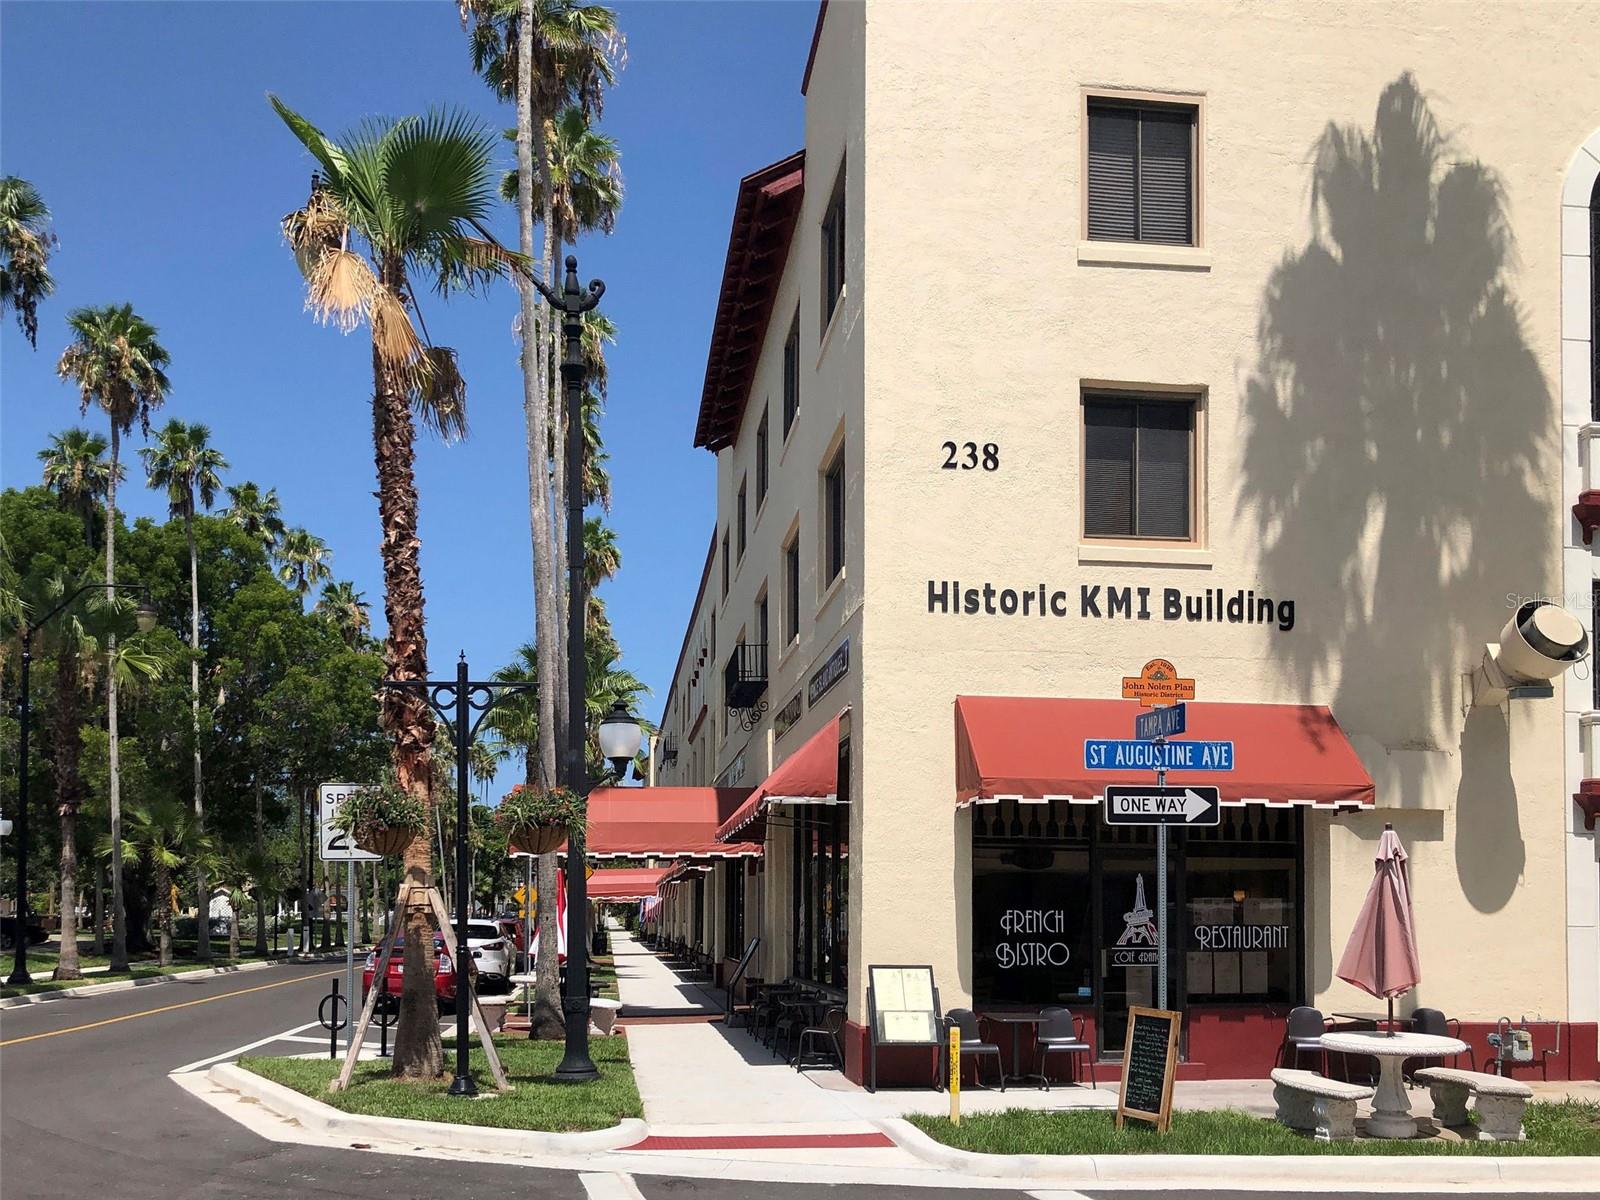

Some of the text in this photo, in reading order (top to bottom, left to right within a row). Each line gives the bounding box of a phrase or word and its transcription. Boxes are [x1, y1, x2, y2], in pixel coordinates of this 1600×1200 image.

[941, 441, 999, 472] 238
[928, 580, 1295, 631] Historic KMI Building
[1124, 682, 1194, 692] John Nolen Plan
[1140, 709, 1180, 738] TAMPA AVE
[1090, 745, 1229, 767] ST AUGUSTINE AVE
[1120, 798, 1187, 813] ONE WAY
[1000, 909, 1064, 936] FRENCH
[1194, 925, 1289, 950] RESTAURANT
[995, 942, 1070, 969] BISTRO
